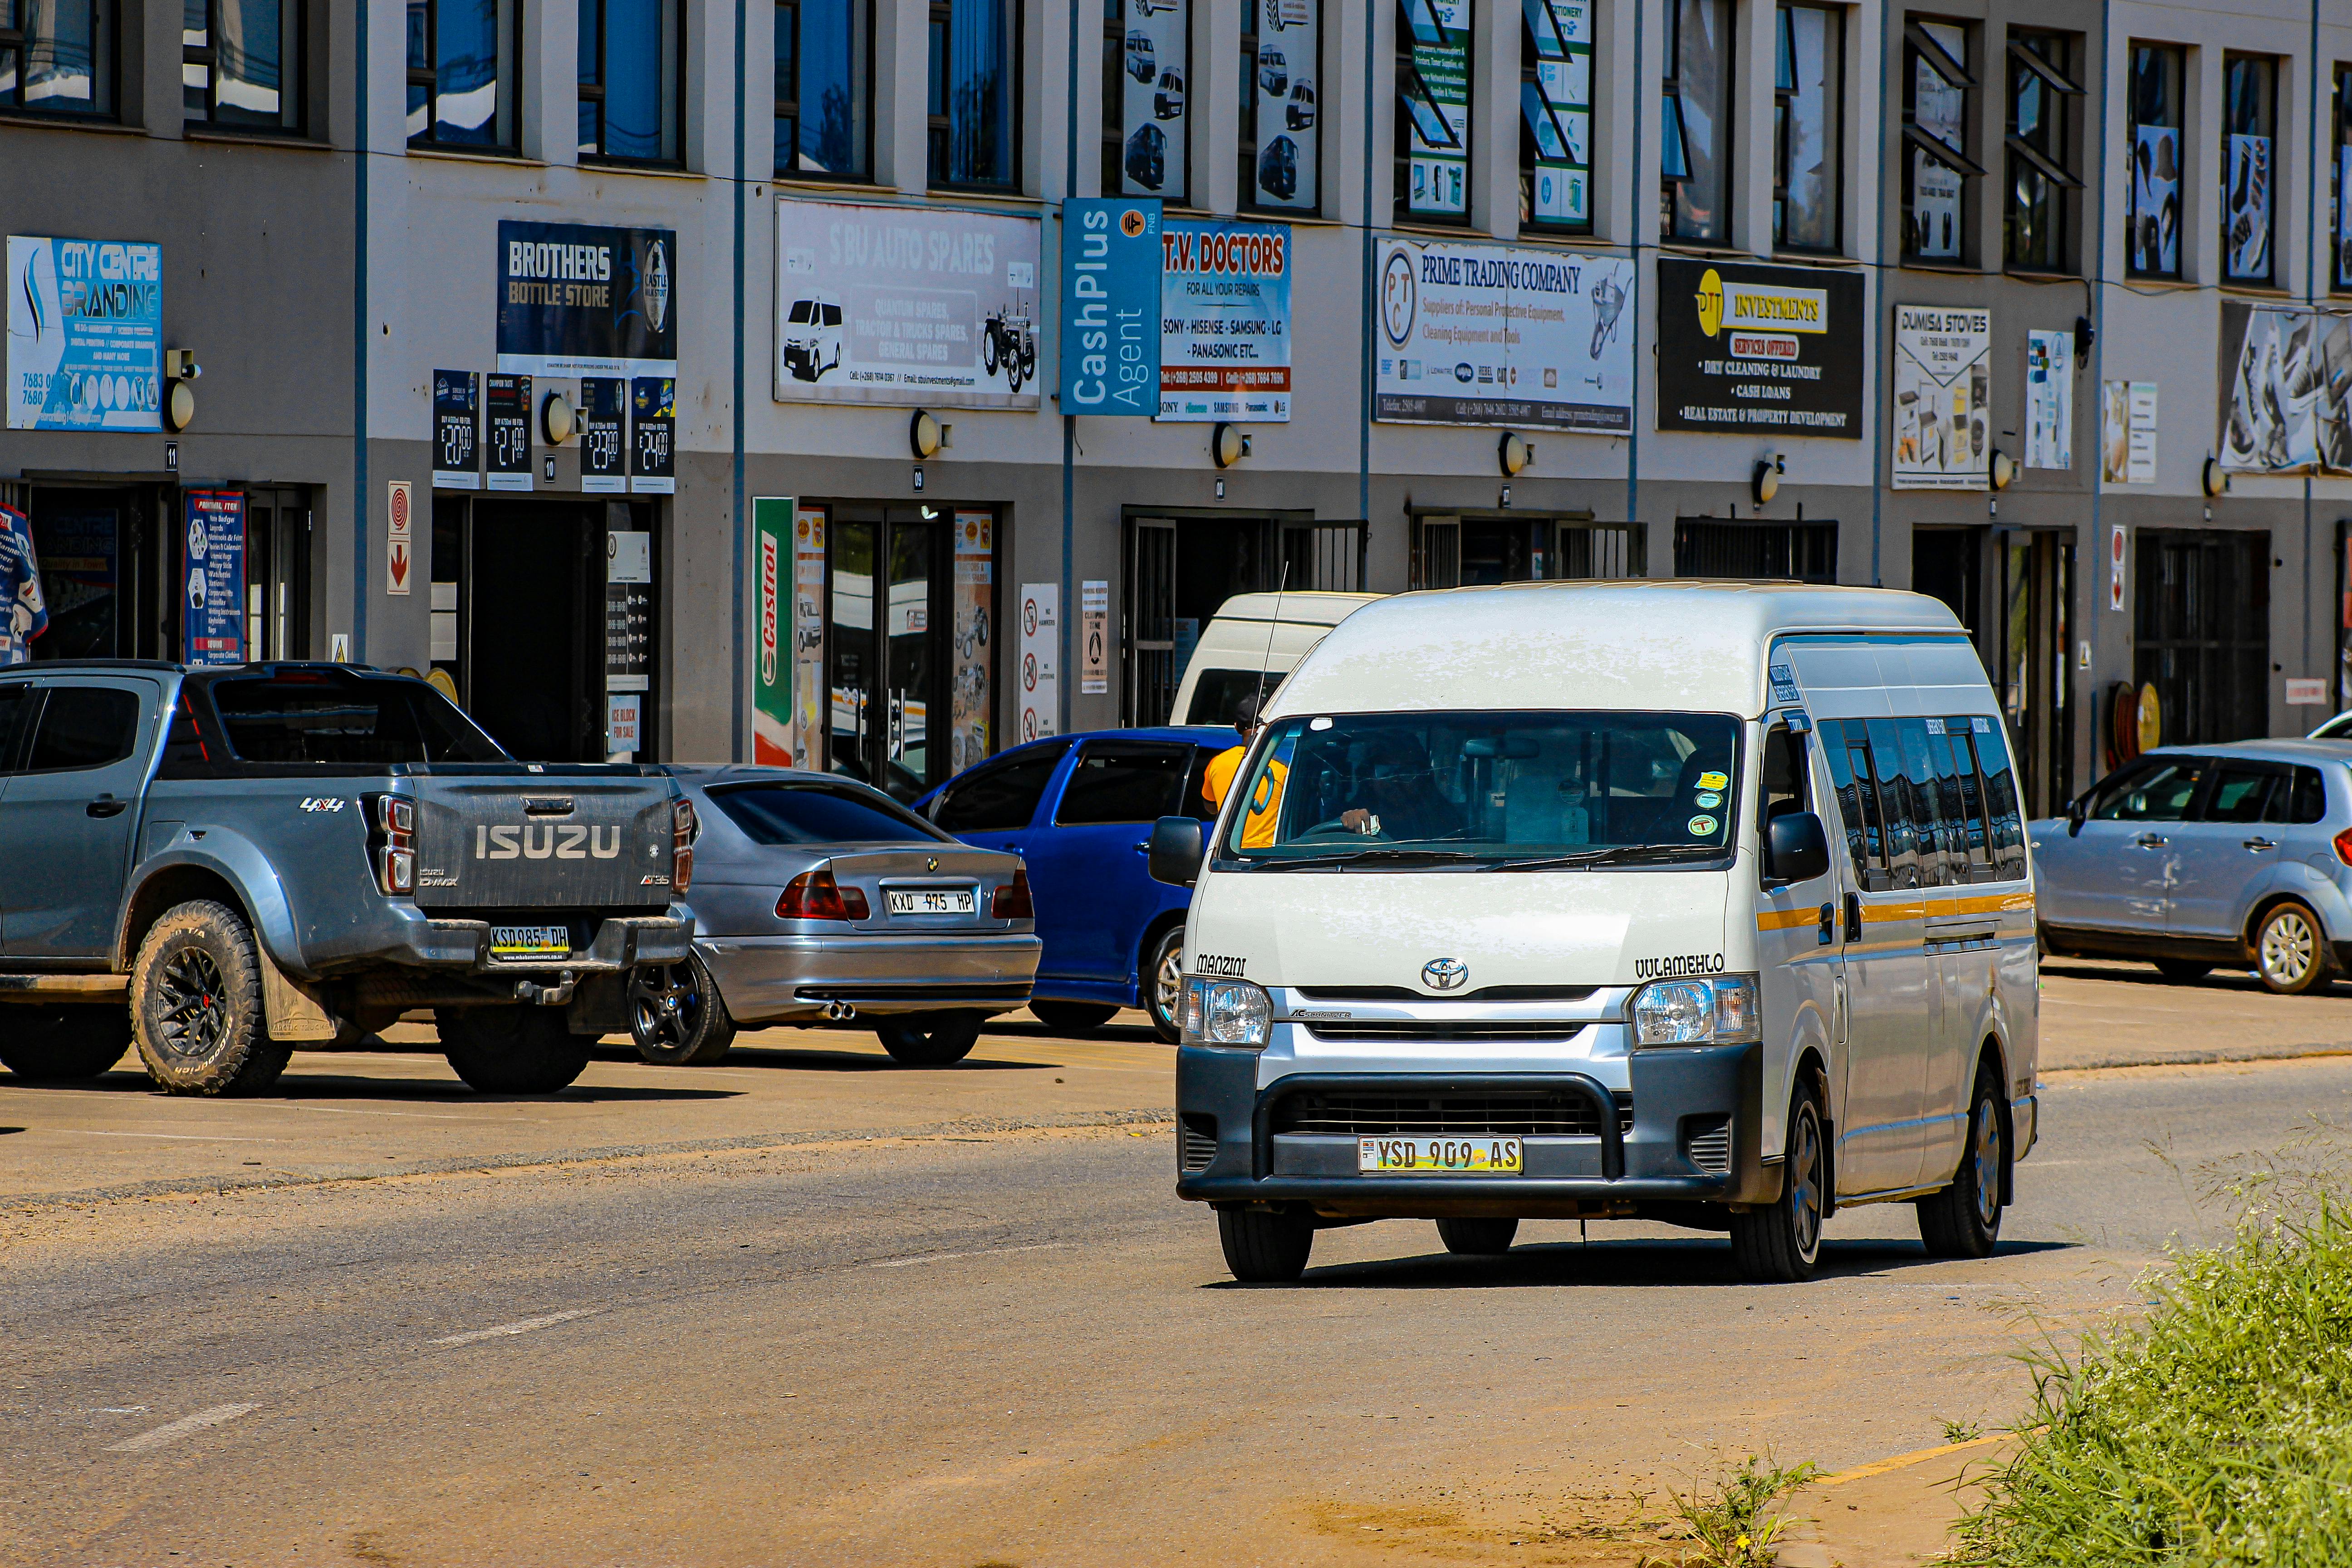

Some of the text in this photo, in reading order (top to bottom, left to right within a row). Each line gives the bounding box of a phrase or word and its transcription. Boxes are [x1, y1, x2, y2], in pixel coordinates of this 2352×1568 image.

[873, 226, 923, 270] AUTO
[928, 230, 995, 274] SPARES
[1162, 232, 1285, 275] T.V. DOCTORS
[61, 242, 158, 281] CITY CENTRE
[509, 241, 610, 280] BROTHERS
[645, 274, 667, 287] CASTLE
[1421, 255, 1582, 294] PRIME TRADING COMPANY
[509, 282, 609, 308] BOTTLE STORE
[654, 289, 667, 298] STOUT
[1186, 282, 1260, 297] FOR ALL YOUR REPAIRS
[61, 280, 157, 319] BRANDING
[1073, 210, 1108, 405] CashPlus
[1422, 297, 1451, 315] Suppliers
[1465, 301, 1493, 317] Personal
[1494, 302, 1527, 319] Protective
[1735, 294, 1819, 321] INVESTMENTS
[1163, 320, 1282, 335] SONY HISENSE SAMSUNG LG
[1902, 312, 1987, 333] DUMISA STOVES
[1422, 326, 1520, 345] Cleaning Equipment and Tools
[93, 352, 102, 360] AND
[916, 343, 948, 361] SPARES
[1112, 308, 1149, 407] Agent
[1192, 344, 1238, 358] PANASONIC
[1204, 371, 1218, 384] 4399
[1705, 360, 1822, 379] DRY CLEANING & LAUNDRY
[23, 373, 43, 388] 7683
[23, 390, 43, 405] 7680
[1736, 384, 1791, 400] CASH LOANS
[1214, 402, 1239, 413] SAMSUNG
[1245, 402, 1268, 412] Panasonic
[1279, 402, 1285, 412] LG
[1684, 406, 1847, 427] REAL ESTATE & PROPERTY DEVELOPMENT
[168, 448, 175, 466] 11
[546, 461, 554, 477] 10
[763, 542, 775, 649] Castrol
[1089, 621, 1101, 630] ZONE
[614, 726, 633, 738] FOR SALE
[476, 825, 621, 859] ISUZU
[891, 893, 971, 911] KXD 975 MP
[550, 928, 567, 947] DH
[1196, 953, 1247, 977] MANZINI
[1635, 952, 1724, 979] VULAMEHLO
[1378, 1141, 1517, 1168] YSD 909 AS
